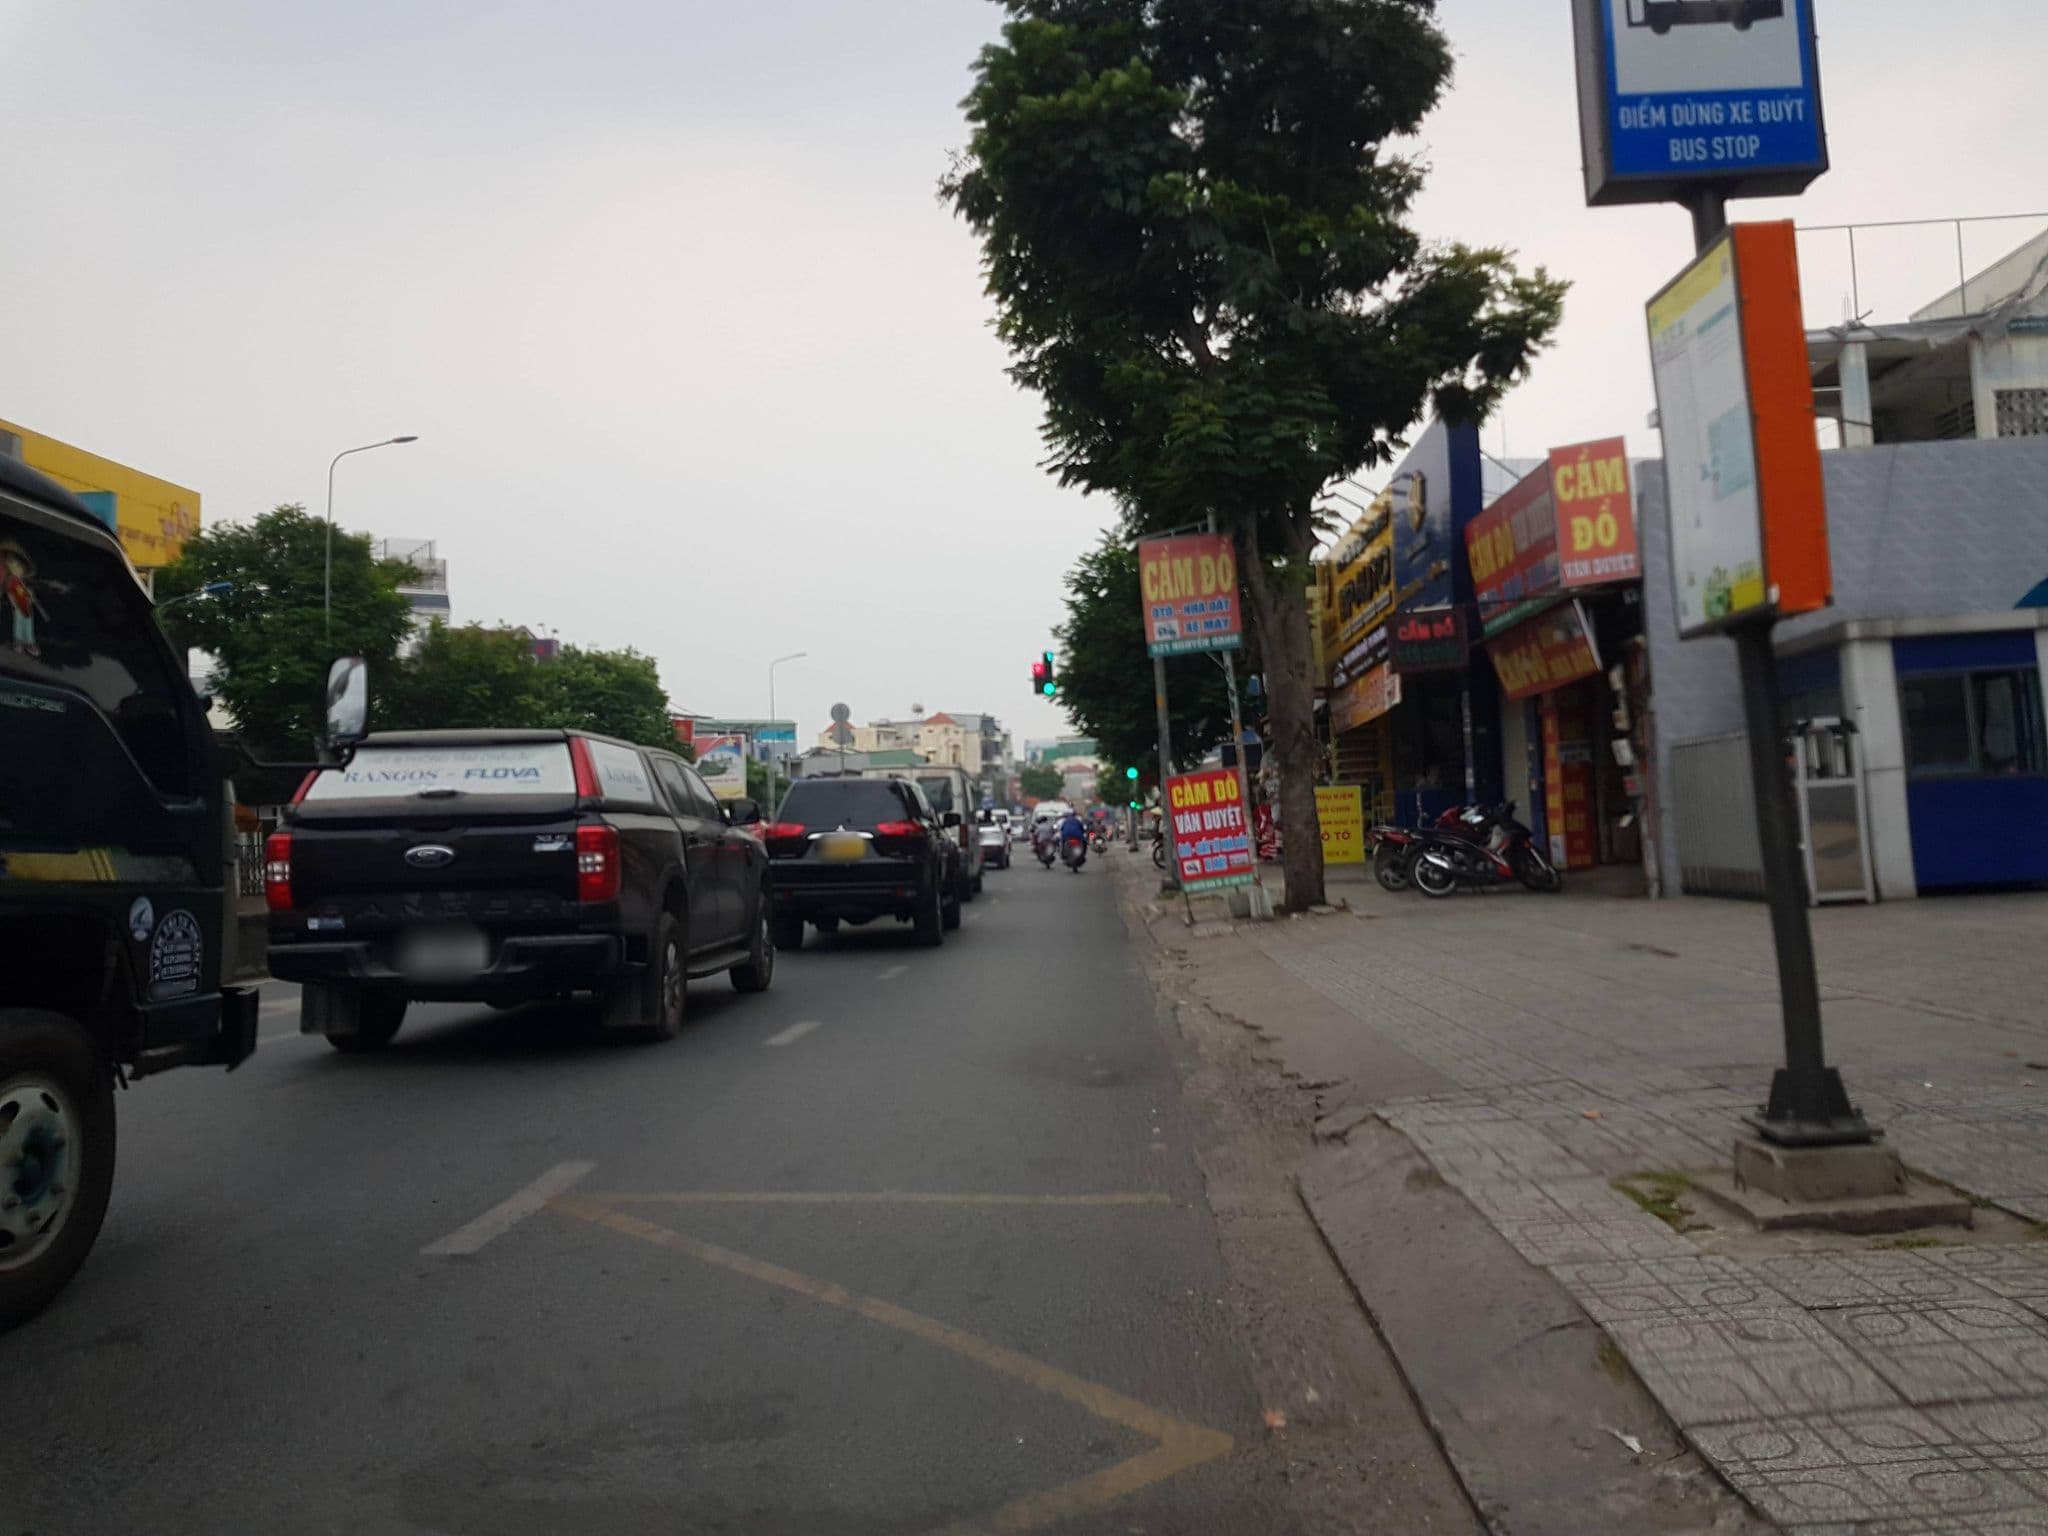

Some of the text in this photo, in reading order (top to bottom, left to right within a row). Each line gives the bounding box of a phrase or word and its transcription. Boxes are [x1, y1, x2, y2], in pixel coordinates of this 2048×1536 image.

[1730, 102, 1754, 124] XE
[1758, 94, 1805, 123] BUÝT
[1669, 136, 1760, 162] BUS STOP
[463, 767, 542, 781] FLOVA
